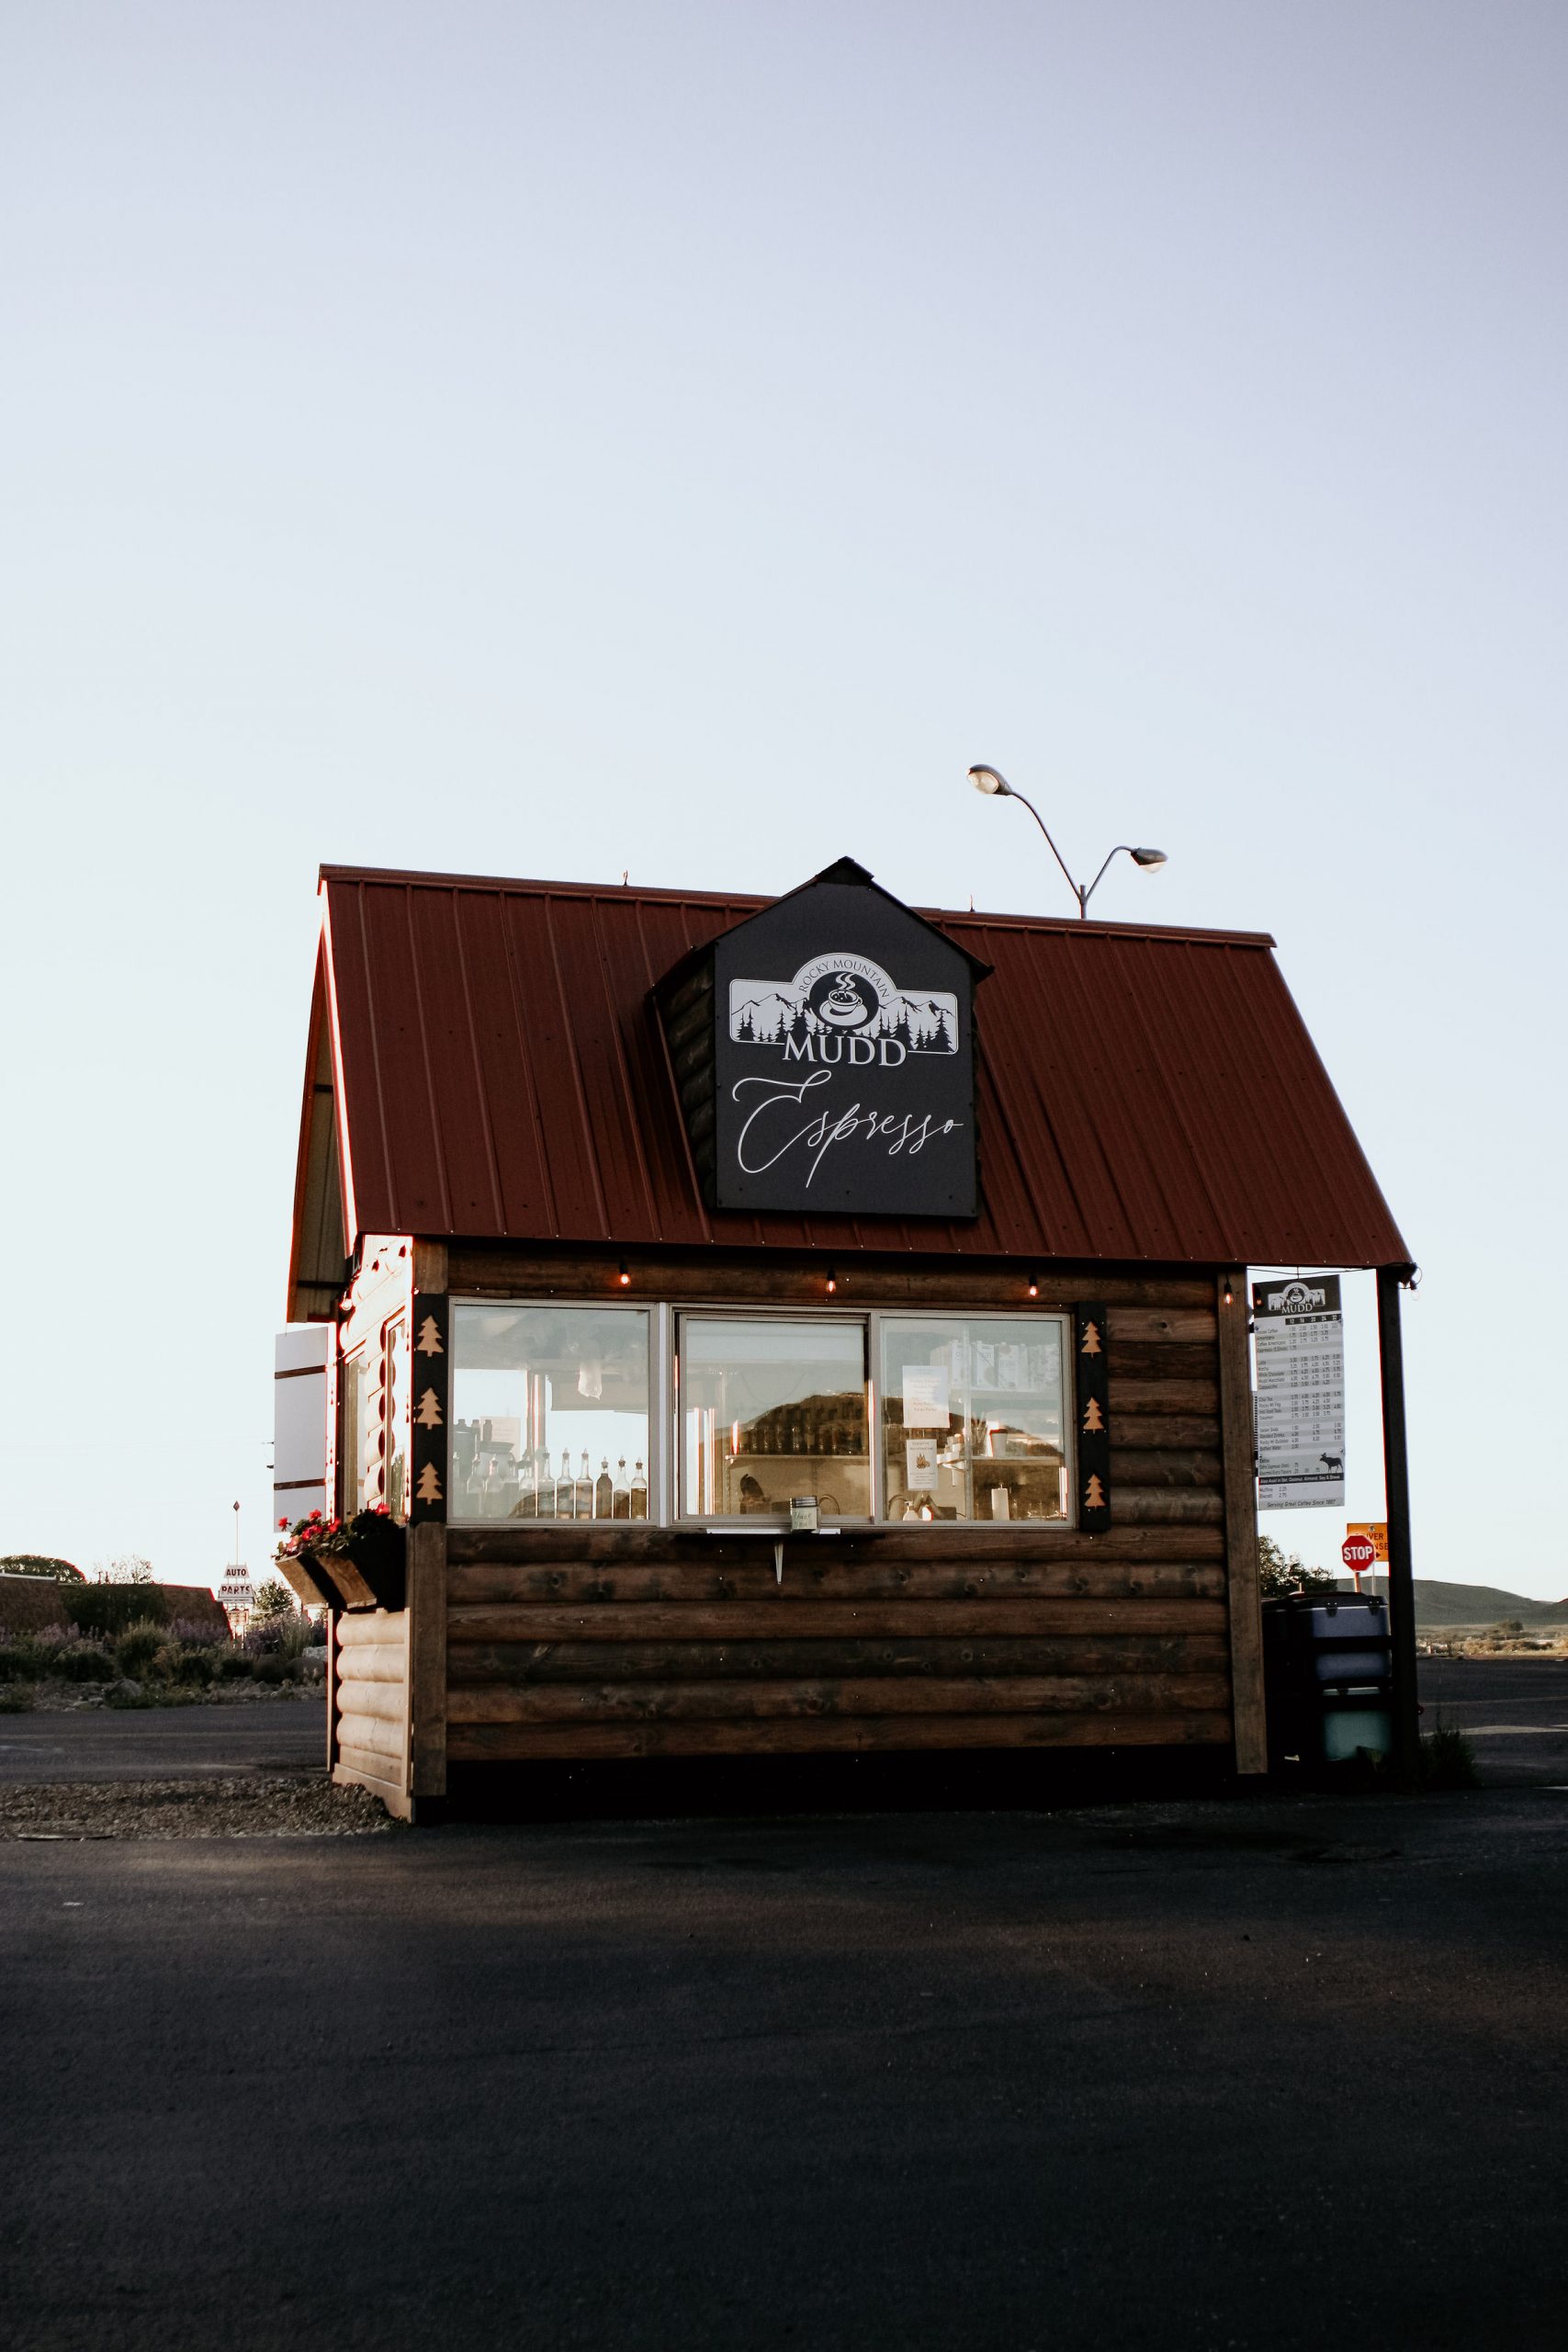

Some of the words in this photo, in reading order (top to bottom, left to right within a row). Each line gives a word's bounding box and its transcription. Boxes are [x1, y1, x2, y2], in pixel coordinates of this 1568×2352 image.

[799, 961, 830, 993] ROCKY
[833, 959, 890, 999] MOUNTAIN
[782, 1033, 907, 1066] MUDD
[732, 1069, 964, 1188] Espresso
[1281, 1303, 1313, 1314] MUDD
[1343, 1545, 1372, 1561] STOP
[226, 1568, 246, 1577] AUTO
[221, 1586, 250, 1595] PARTS
